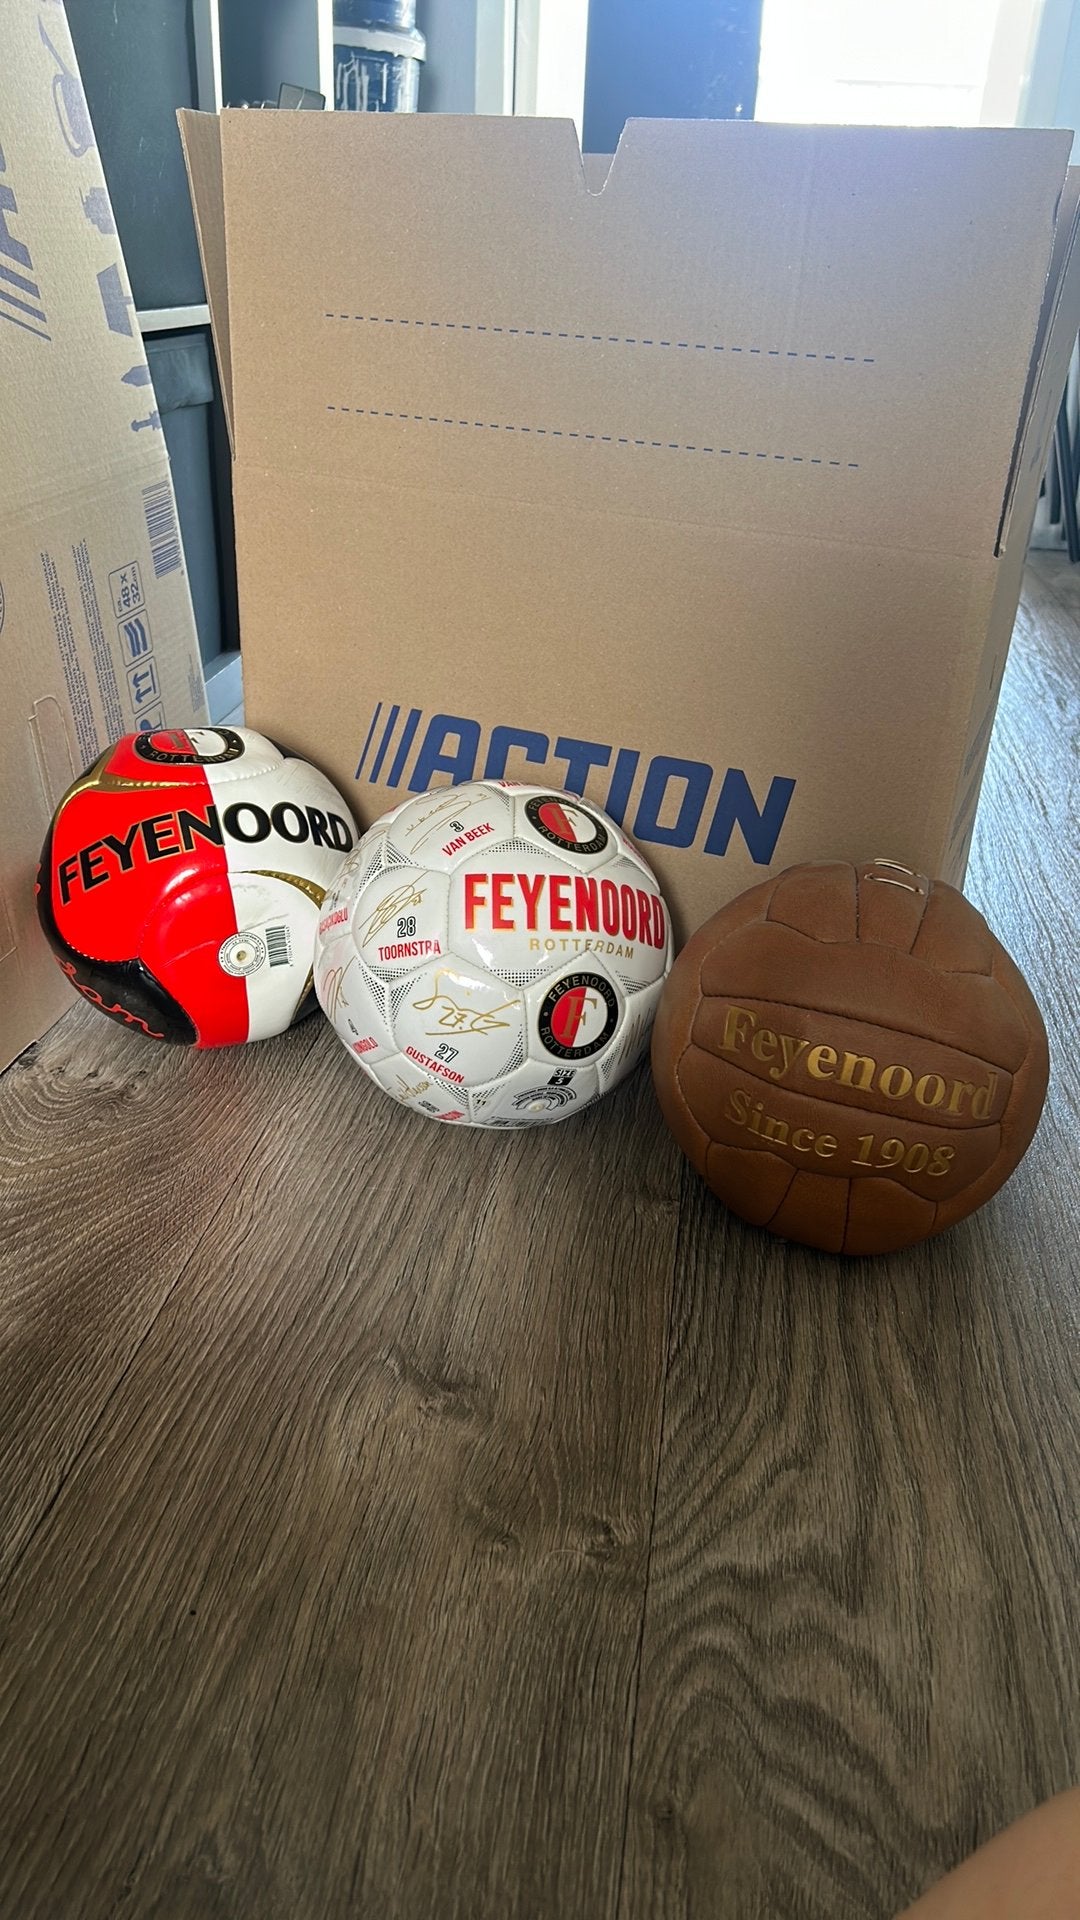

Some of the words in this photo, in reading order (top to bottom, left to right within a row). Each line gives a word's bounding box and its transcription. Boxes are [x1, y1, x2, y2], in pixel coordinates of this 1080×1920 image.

[121, 585, 131, 608] 48
[408, 714, 797, 866] ACTION
[442, 836, 467, 857] VAN
[464, 822, 495, 843] BEEK
[449, 820, 465, 833] 3
[538, 825, 608, 853] ROTTERDAM
[58, 802, 354, 905] FEYENOORD
[396, 915, 417, 939] 28
[463, 872, 667, 951] FEYENOORD
[378, 939, 442, 962] TOORNSTRA
[529, 937, 635, 960] ROTTERDAM
[548, 974, 616, 1008] FEYENOORD
[434, 1042, 460, 1064] 27
[540, 1026, 610, 1058] ROTTERDAM
[405, 1045, 465, 1084] GUSTAFSON
[718, 1004, 999, 1121] Feyenoord
[724, 1087, 839, 1158] Since
[850, 1133, 957, 1177] 1908
